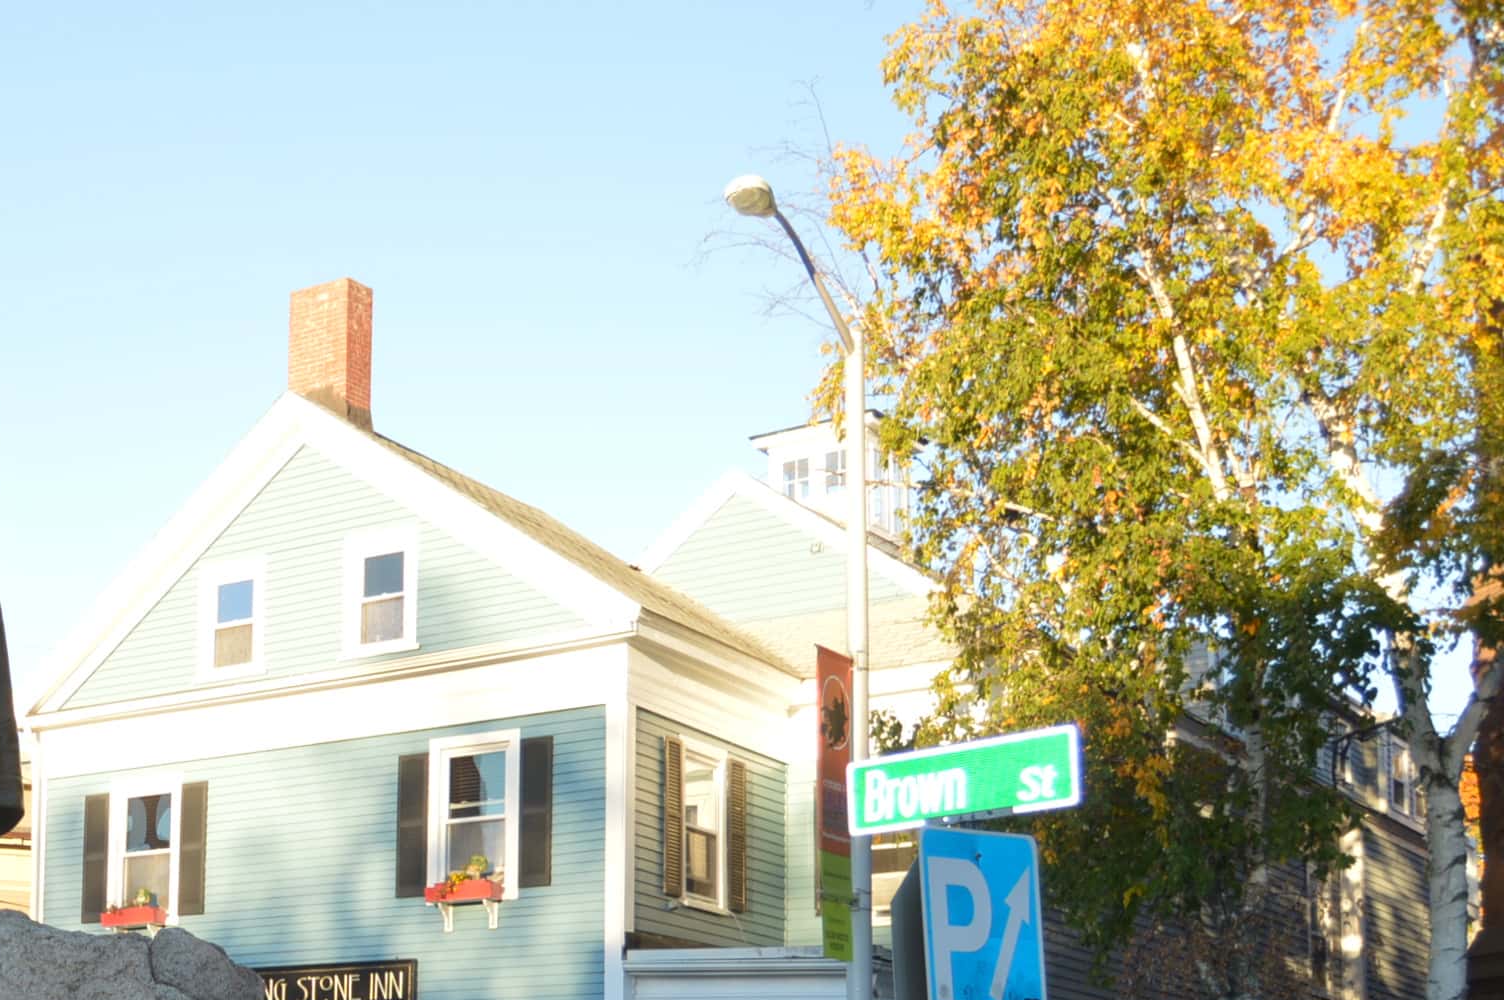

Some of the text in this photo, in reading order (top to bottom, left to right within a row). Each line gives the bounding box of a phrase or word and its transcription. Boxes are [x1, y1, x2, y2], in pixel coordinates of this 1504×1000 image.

[864, 767, 966, 823] Brown
[1016, 763, 1057, 801] St
[369, 971, 403, 1000] INN
